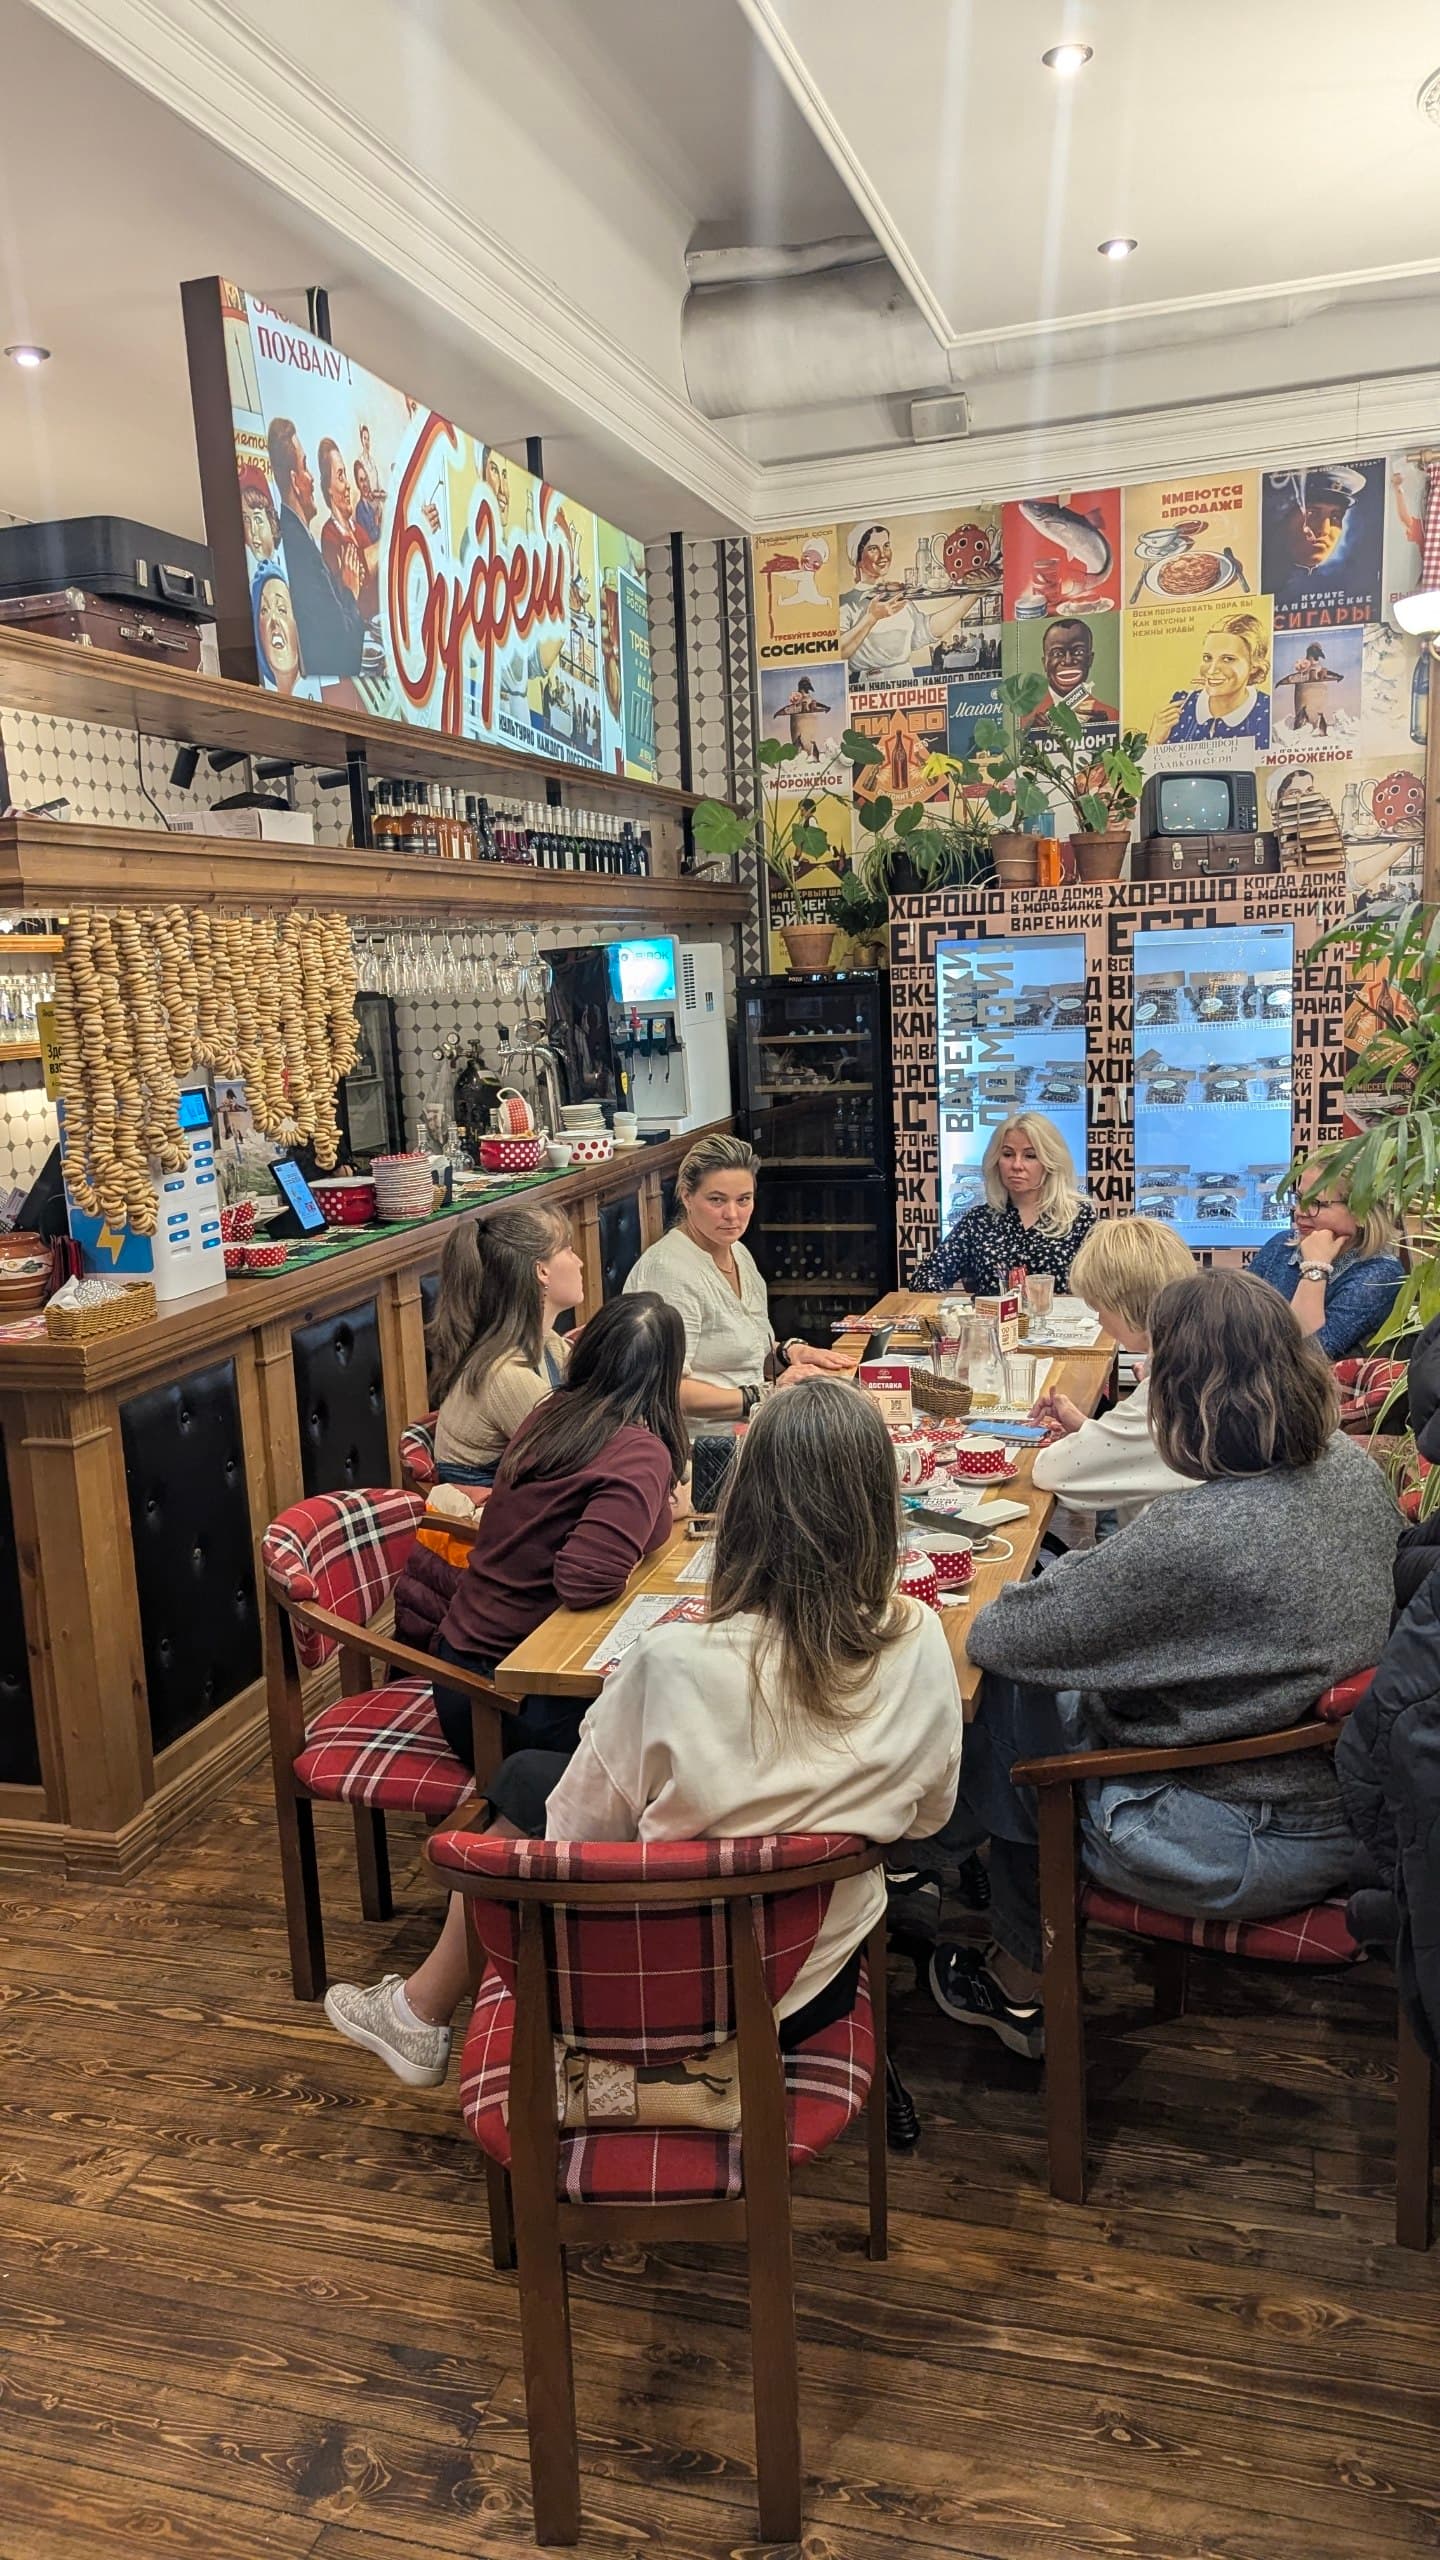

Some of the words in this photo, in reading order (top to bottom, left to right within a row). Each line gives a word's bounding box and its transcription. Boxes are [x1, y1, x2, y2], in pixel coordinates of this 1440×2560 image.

[257, 326, 352, 385] ПОХВАЛУ!
[1161, 484, 1244, 506] ИМЕЮТСЯ
[1170, 498, 1244, 517] ПРОДАЖЕ
[1301, 590, 1345, 602] КУРИТЕ
[1154, 605, 1213, 617] ПОПРОБОВАТЬ
[1273, 605, 1372, 630] СИГАРЫ
[1152, 616, 1187, 626] ВКУСНЫ
[773, 630, 811, 641] ТРЕБУЙТЕ
[1132, 628, 1163, 637] НЕЖНЫ
[760, 638, 839, 658] СОСИСКИ
[869, 678, 919, 691] КУЛЬТУРНО
[922, 673, 965, 686] КАЖДОГО
[850, 686, 947, 711] ТРЕХГОРНОЕ
[499, 713, 535, 747] КУЛЬТУРНО
[1266, 750, 1354, 765] МОРОЖЕНОЕ
[769, 775, 843, 790] МОРОЖЕНОЕ
[1244, 875, 1296, 890] КОГДА
[1301, 871, 1347, 889] ДОМА
[1010, 888, 1058, 903] КОГДА
[1061, 886, 1104, 902] ДОМА
[1107, 877, 1237, 908] ХОРОШО
[1243, 890, 1251, 901] В
[890, 891, 1005, 920] ХОРОШО
[1010, 902, 1020, 914] В
[1243, 901, 1346, 920] ВАРЕНИКИ
[1010, 913, 1103, 932] ВАРЕНИКИ
[942, 946, 974, 1132] ВАРЕНИКИ
